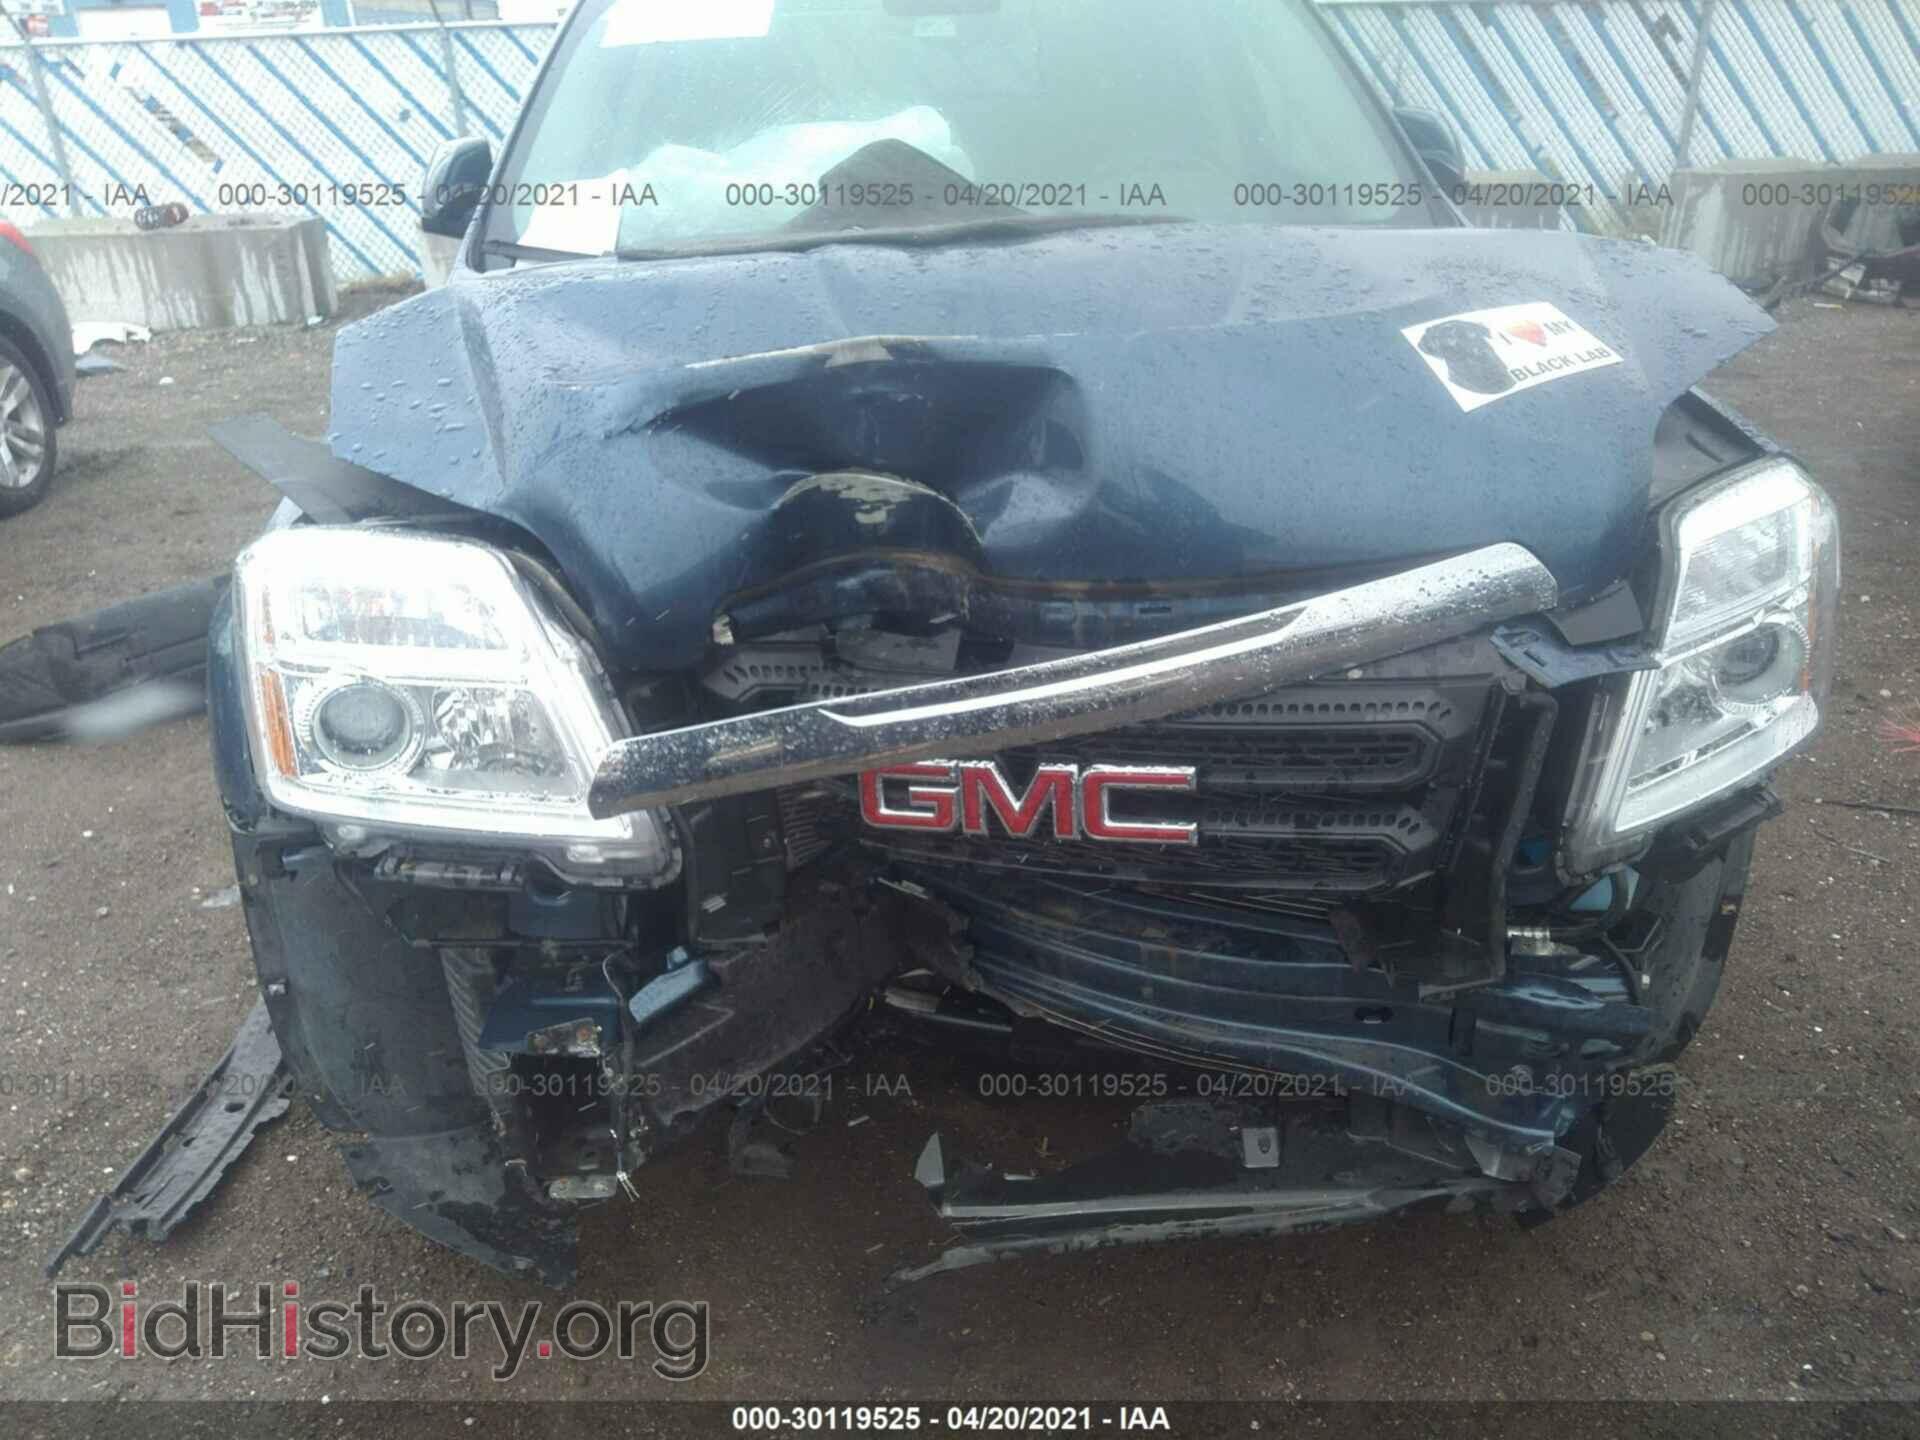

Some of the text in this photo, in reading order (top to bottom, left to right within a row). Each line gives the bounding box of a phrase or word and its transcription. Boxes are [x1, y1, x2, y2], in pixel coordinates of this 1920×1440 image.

[1544, 319, 1575, 336] MY
[1510, 347, 1612, 383] BLACK LAB
[859, 758, 1198, 846] GMC
